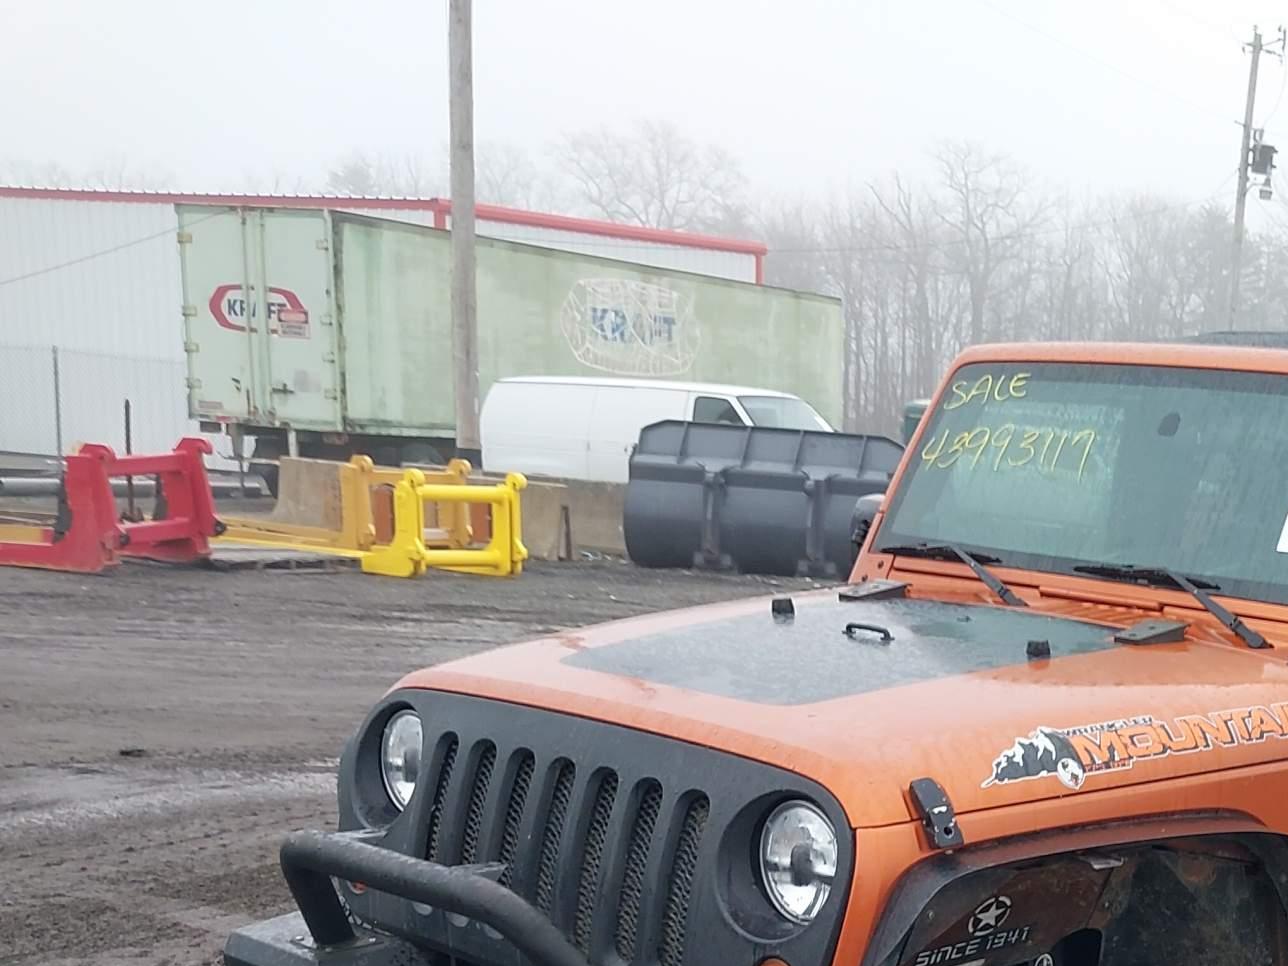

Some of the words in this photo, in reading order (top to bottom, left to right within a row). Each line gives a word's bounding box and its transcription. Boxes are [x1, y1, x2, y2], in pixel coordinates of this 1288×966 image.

[943, 373, 1031, 409] SALE
[921, 423, 1095, 484] 43993117
[986, 926, 1030, 950] 1941
